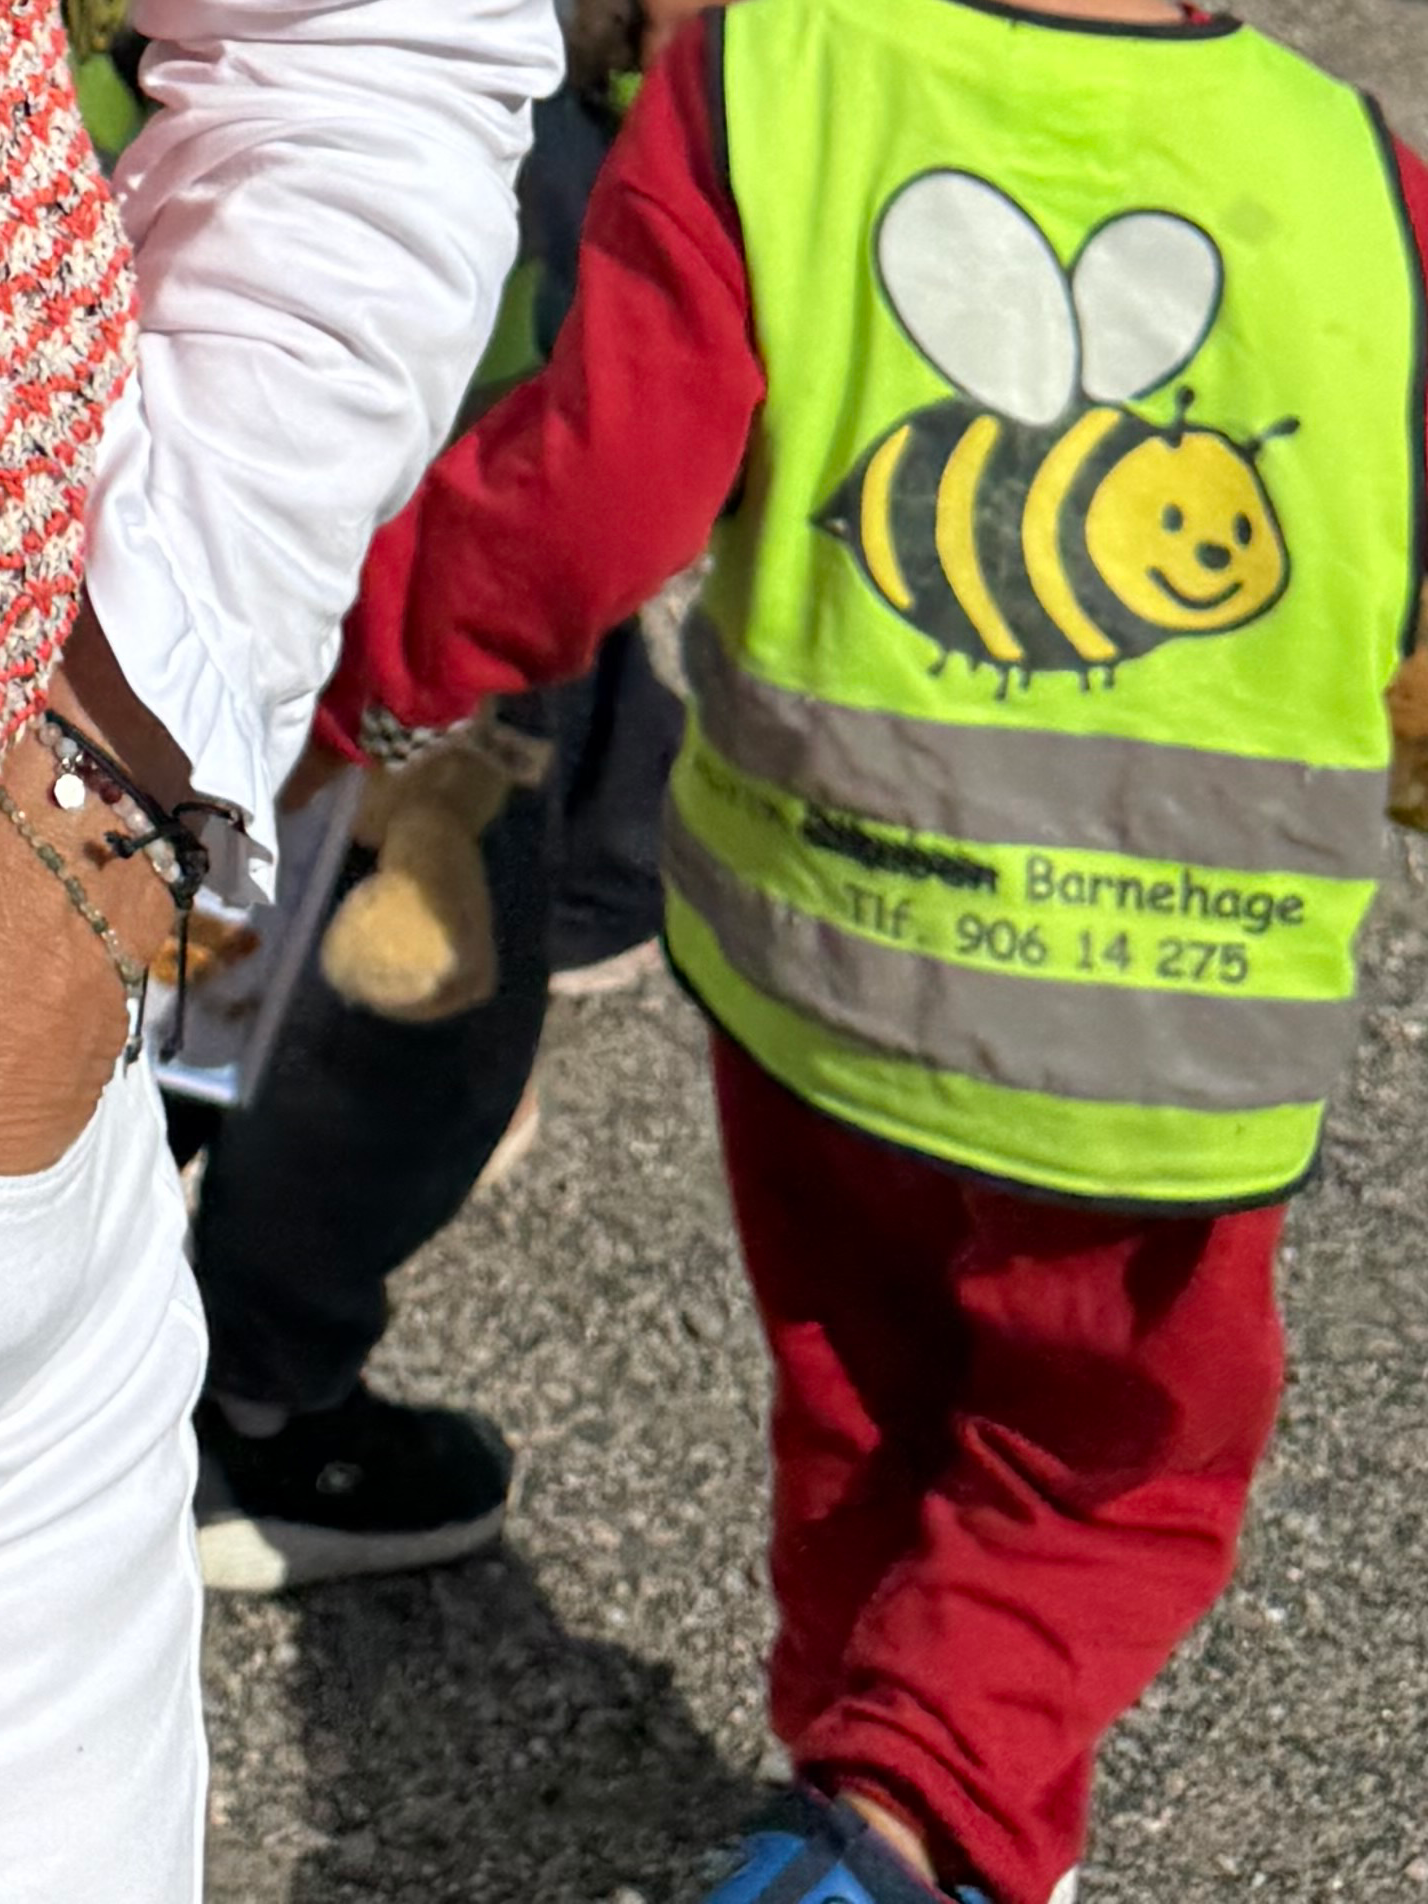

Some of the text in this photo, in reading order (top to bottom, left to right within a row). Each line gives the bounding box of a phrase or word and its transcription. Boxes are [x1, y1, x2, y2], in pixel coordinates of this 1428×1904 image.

[1025, 854, 1306, 933] Barnehage
[956, 912, 1046, 967] 906
[1077, 930, 1131, 972] 14
[1156, 939, 1249, 985] 275
